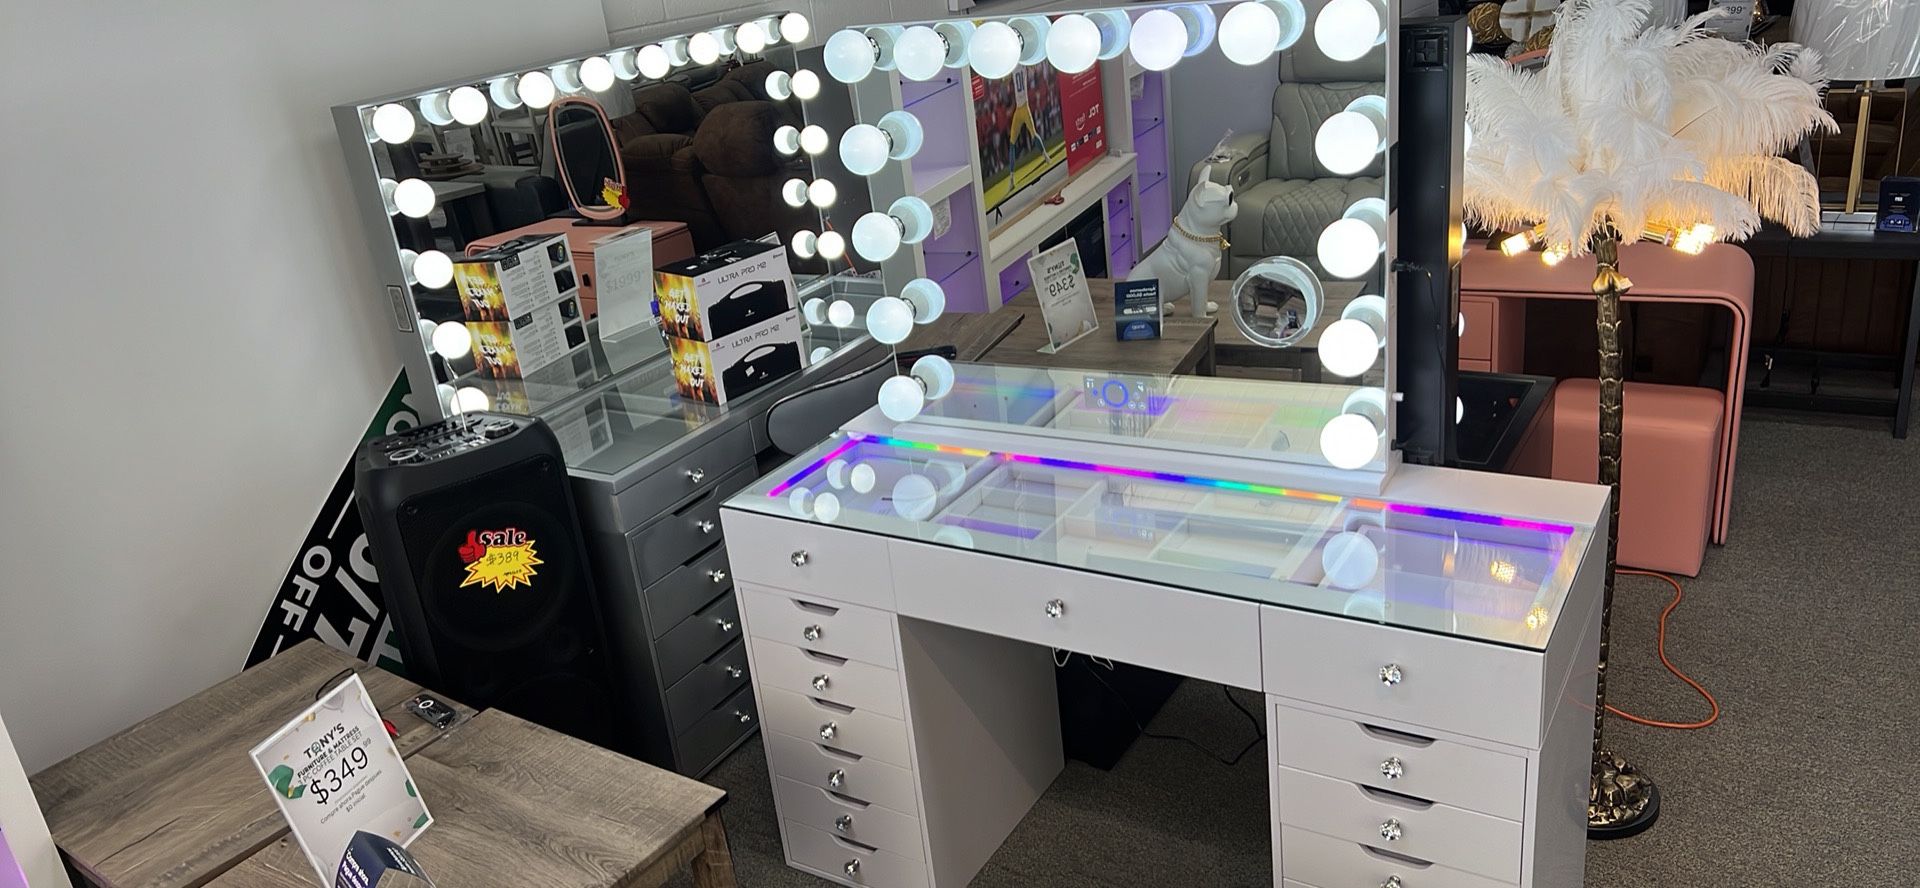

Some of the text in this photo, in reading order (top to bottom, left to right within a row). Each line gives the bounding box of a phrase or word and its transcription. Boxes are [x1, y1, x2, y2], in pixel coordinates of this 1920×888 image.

[740, 265, 756, 277] PRO
[754, 328, 769, 340] PRO
[480, 527, 527, 548] sale
[486, 550, 519, 567] $389
[280, 545, 332, 632] OFF
[297, 752, 328, 779] FURNITURE
[333, 725, 360, 749] MATTRESS
[303, 723, 345, 759] TONY'S
[311, 755, 335, 776] COFFEE
[334, 741, 352, 757] TABLE
[351, 731, 363, 744] SET
[310, 746, 369, 806] $349
